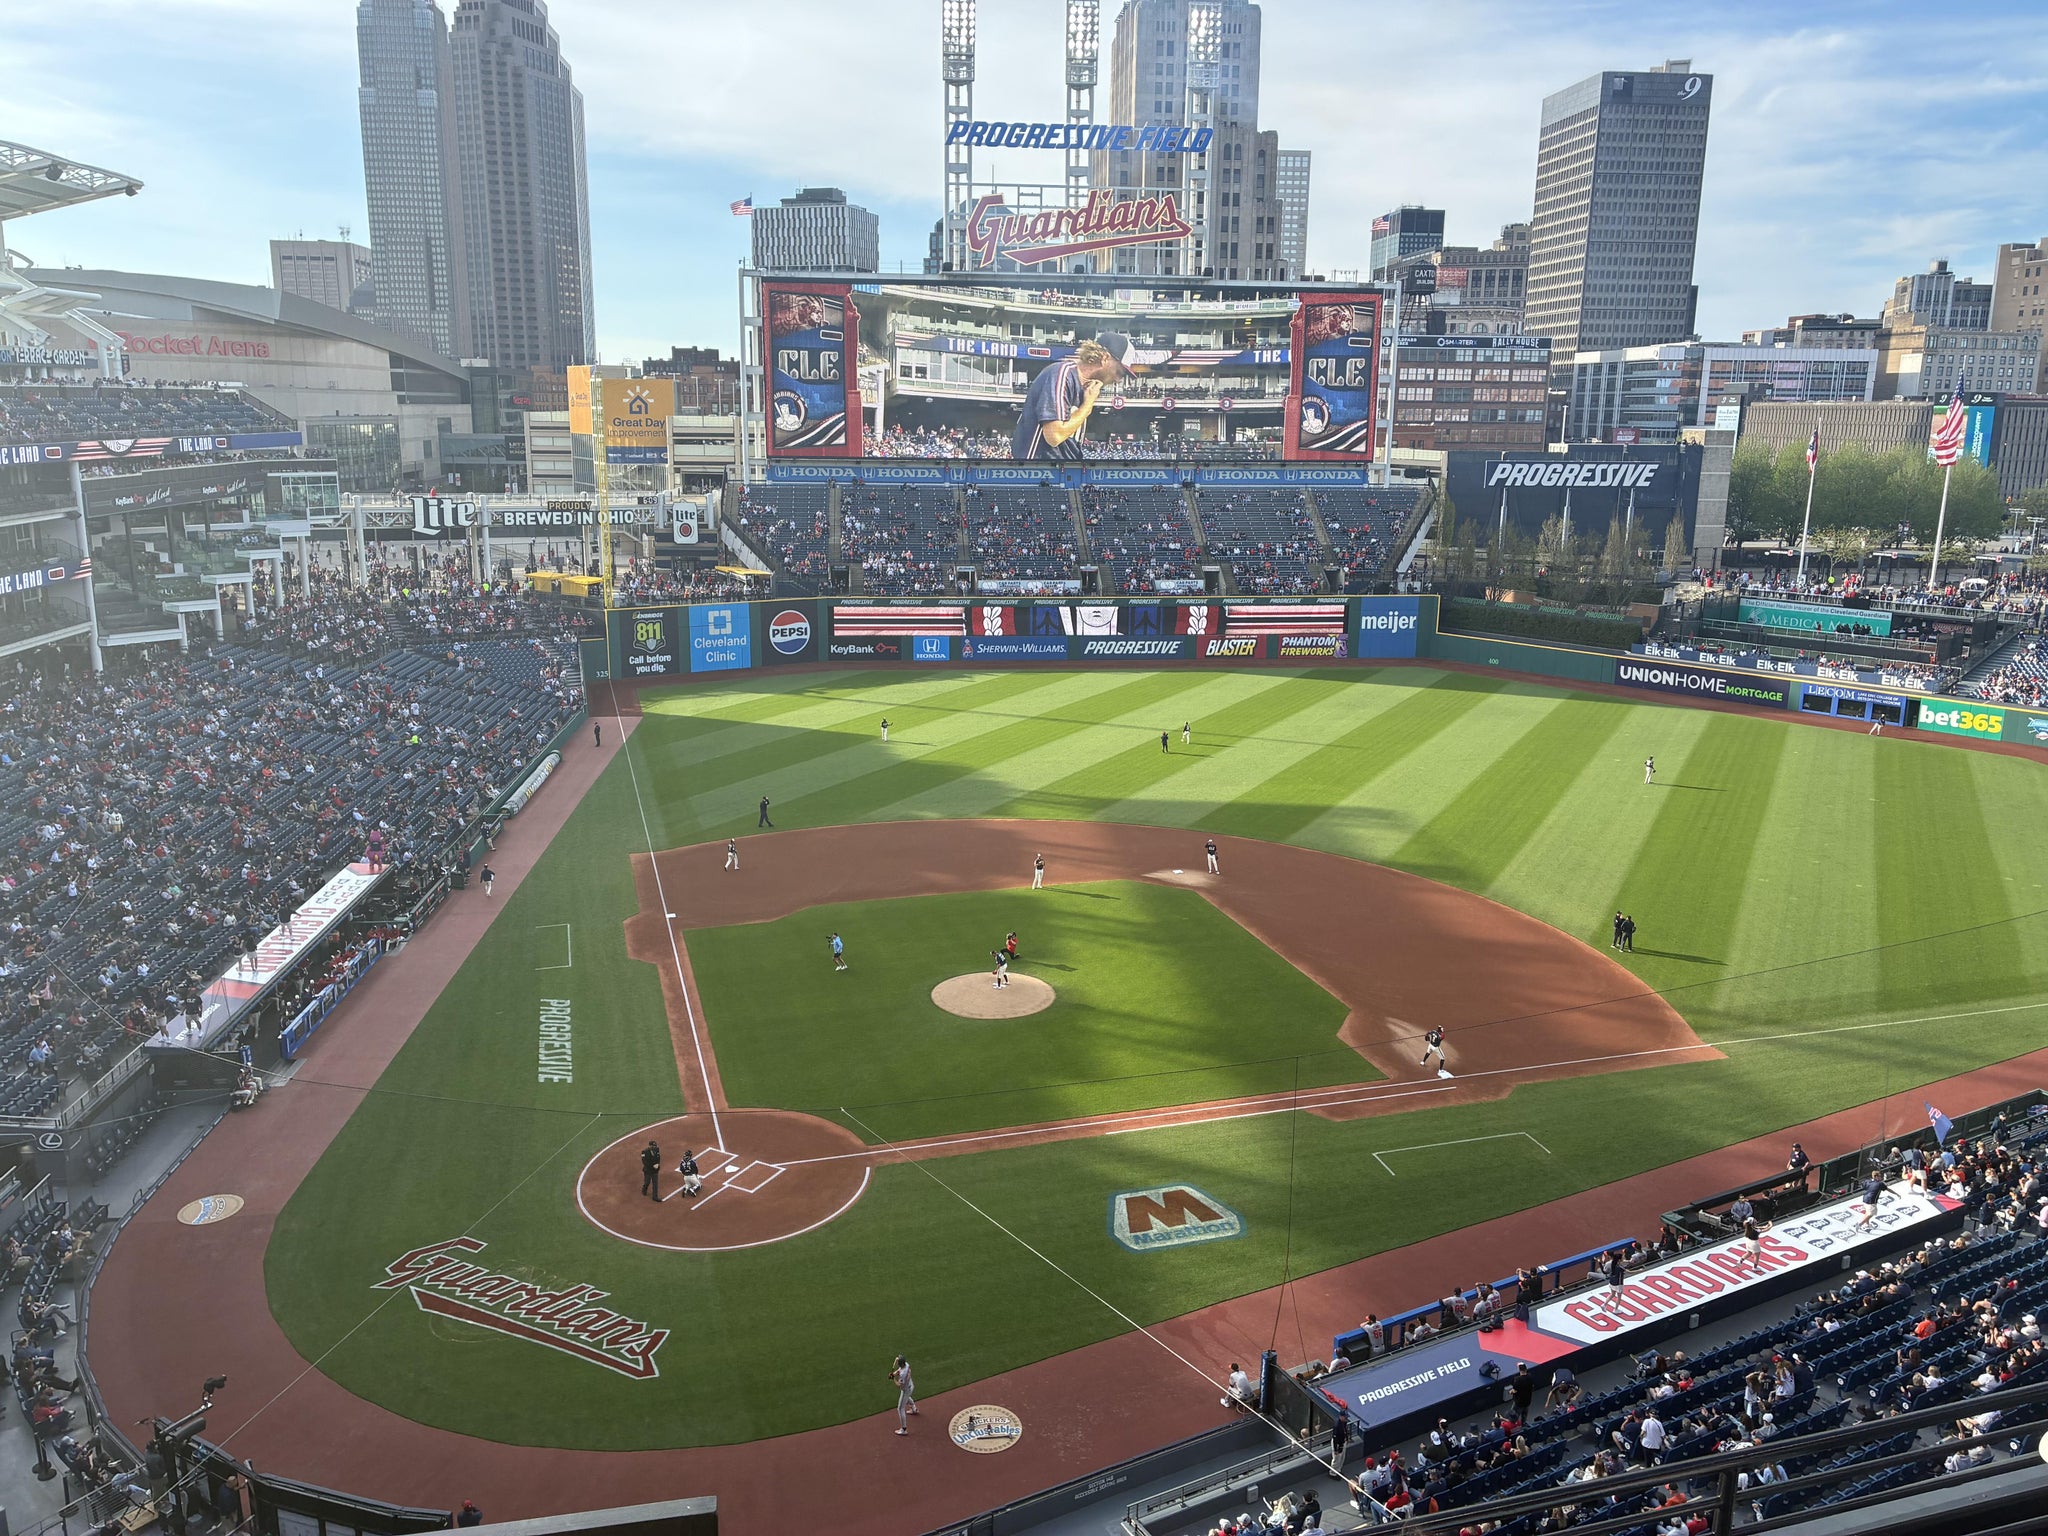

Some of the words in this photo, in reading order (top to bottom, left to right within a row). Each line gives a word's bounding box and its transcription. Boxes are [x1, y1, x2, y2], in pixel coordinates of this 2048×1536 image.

[1681, 77, 1702, 100] 9
[944, 120, 1137, 151] PROGRESSIVE
[1133, 124, 1214, 153] FIELD
[966, 188, 1194, 268] Guardians
[114, 330, 202, 355] Rocket
[208, 335, 271, 359] Arena
[946, 337, 975, 353] THE
[981, 342, 1018, 357] LAND
[1492, 338, 1514, 349] RALLY
[1515, 338, 1540, 349] HOUSE
[778, 350, 840, 380] CLE
[1307, 357, 1367, 388] CLE
[612, 417, 643, 428] Great
[645, 417, 666, 431] Day
[178, 438, 194, 452] THE
[194, 437, 213, 451] LAND
[12, 445, 40, 464] LAND
[791, 466, 857, 478] HONDA
[876, 467, 942, 479] HONDA
[991, 469, 1055, 480] HONDA
[1105, 470, 1168, 480] HONDA
[1217, 471, 1280, 481] HONDA
[1299, 471, 1361, 481] HONDA
[1488, 463, 1660, 487] PROGRESSIVE
[548, 501, 592, 511] PROUDLY
[411, 495, 476, 535] Lite
[504, 511, 573, 526] BREWED
[577, 511, 593, 525] IN
[597, 511, 635, 526] OHIO
[674, 509, 696, 521] Lite
[16, 568, 43, 591] LAND
[1830, 608, 1858, 616] Cleveland
[1859, 611, 1890, 619] Guardians
[1361, 611, 1417, 633] meijer
[636, 621, 662, 642] 811
[772, 625, 808, 638] PEPSI
[694, 635, 747, 650] Cleveland
[830, 643, 875, 655] KeyBank
[1084, 641, 1181, 655] PROGRESSIVE
[1205, 639, 1257, 656] BLASTER
[1281, 636, 1336, 647] PHANTOM
[629, 655, 644, 665] Call
[646, 653, 671, 664] before
[705, 650, 736, 663] Clinic
[1280, 647, 1335, 656] FIREWORKS
[595, 670, 609, 678] 325
[636, 665, 650, 675] you
[651, 663, 666, 673] dig.
[1725, 685, 1783, 702] MORTGAGE
[1919, 705, 2003, 733] bet365
[538, 998, 573, 1084] PROGRESSIVE
[1133, 1221, 1235, 1246] Marathon
[1563, 1235, 1809, 1332] GUARDIANS
[370, 1236, 671, 1380] Guardians
[1358, 1369, 1438, 1406] PROGRESSIVE
[1437, 1357, 1472, 1377] FIELD
